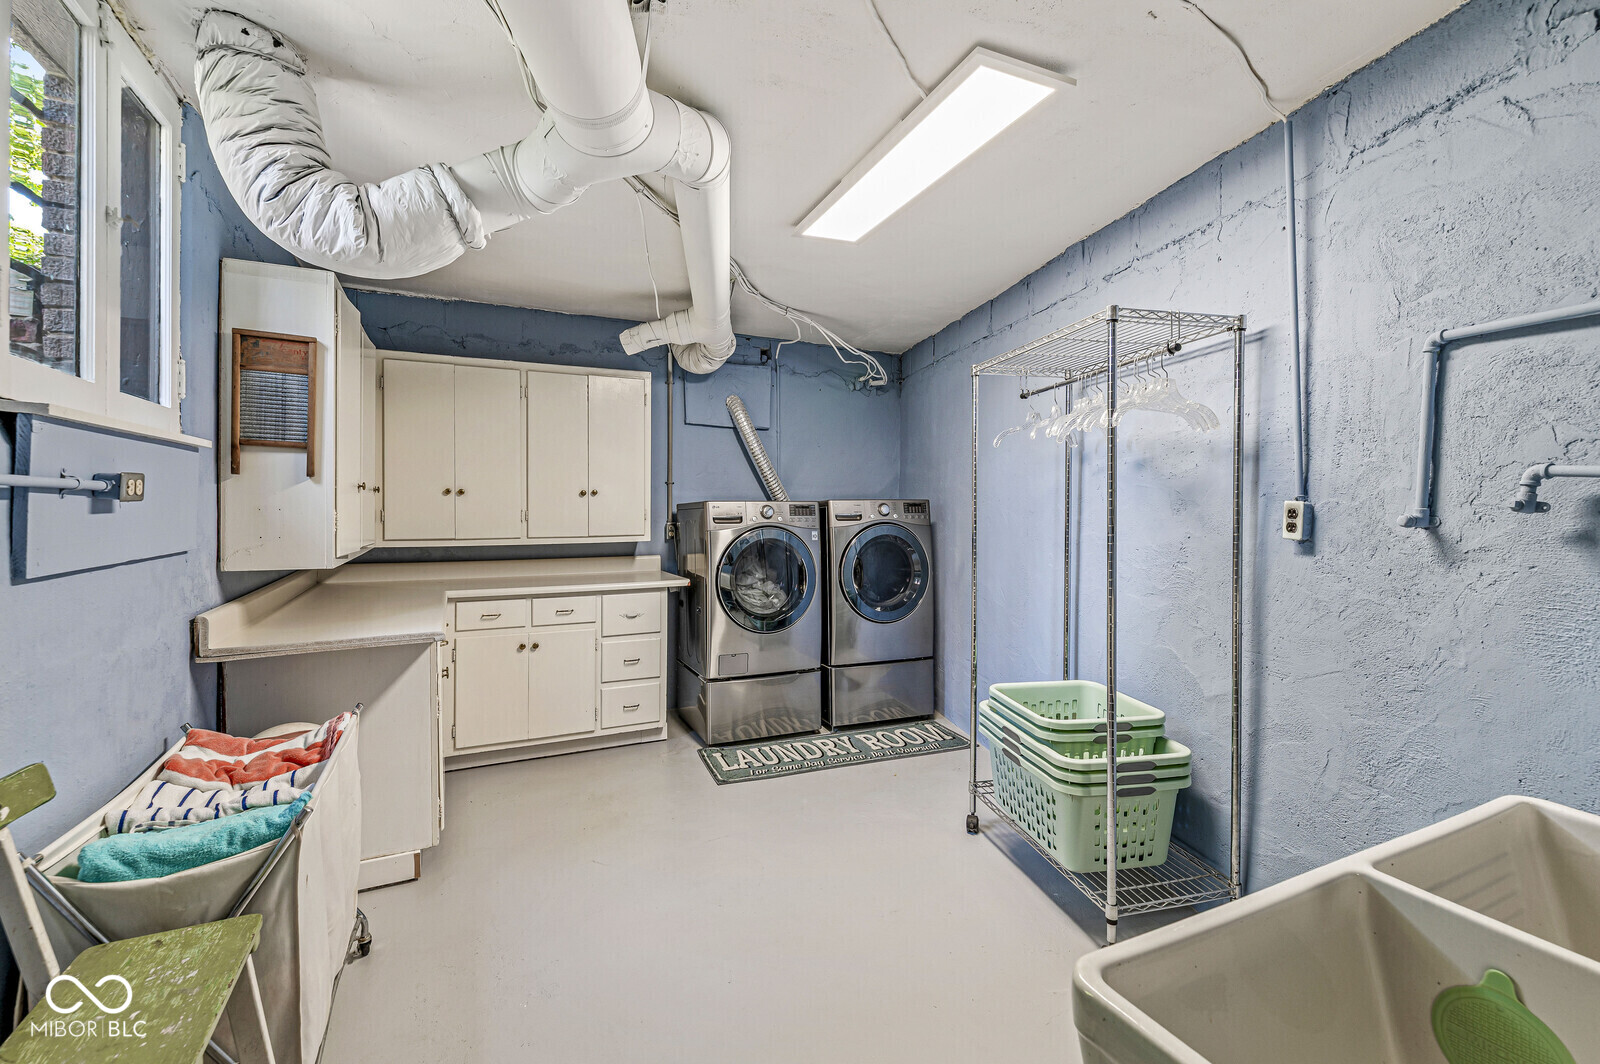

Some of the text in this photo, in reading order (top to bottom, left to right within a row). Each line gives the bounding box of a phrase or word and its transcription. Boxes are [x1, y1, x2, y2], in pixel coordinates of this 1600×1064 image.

[712, 737, 858, 771] LAUNDRY
[855, 724, 953, 750] ROOM
[750, 768, 770, 776] For
[771, 764, 802, 772] Same
